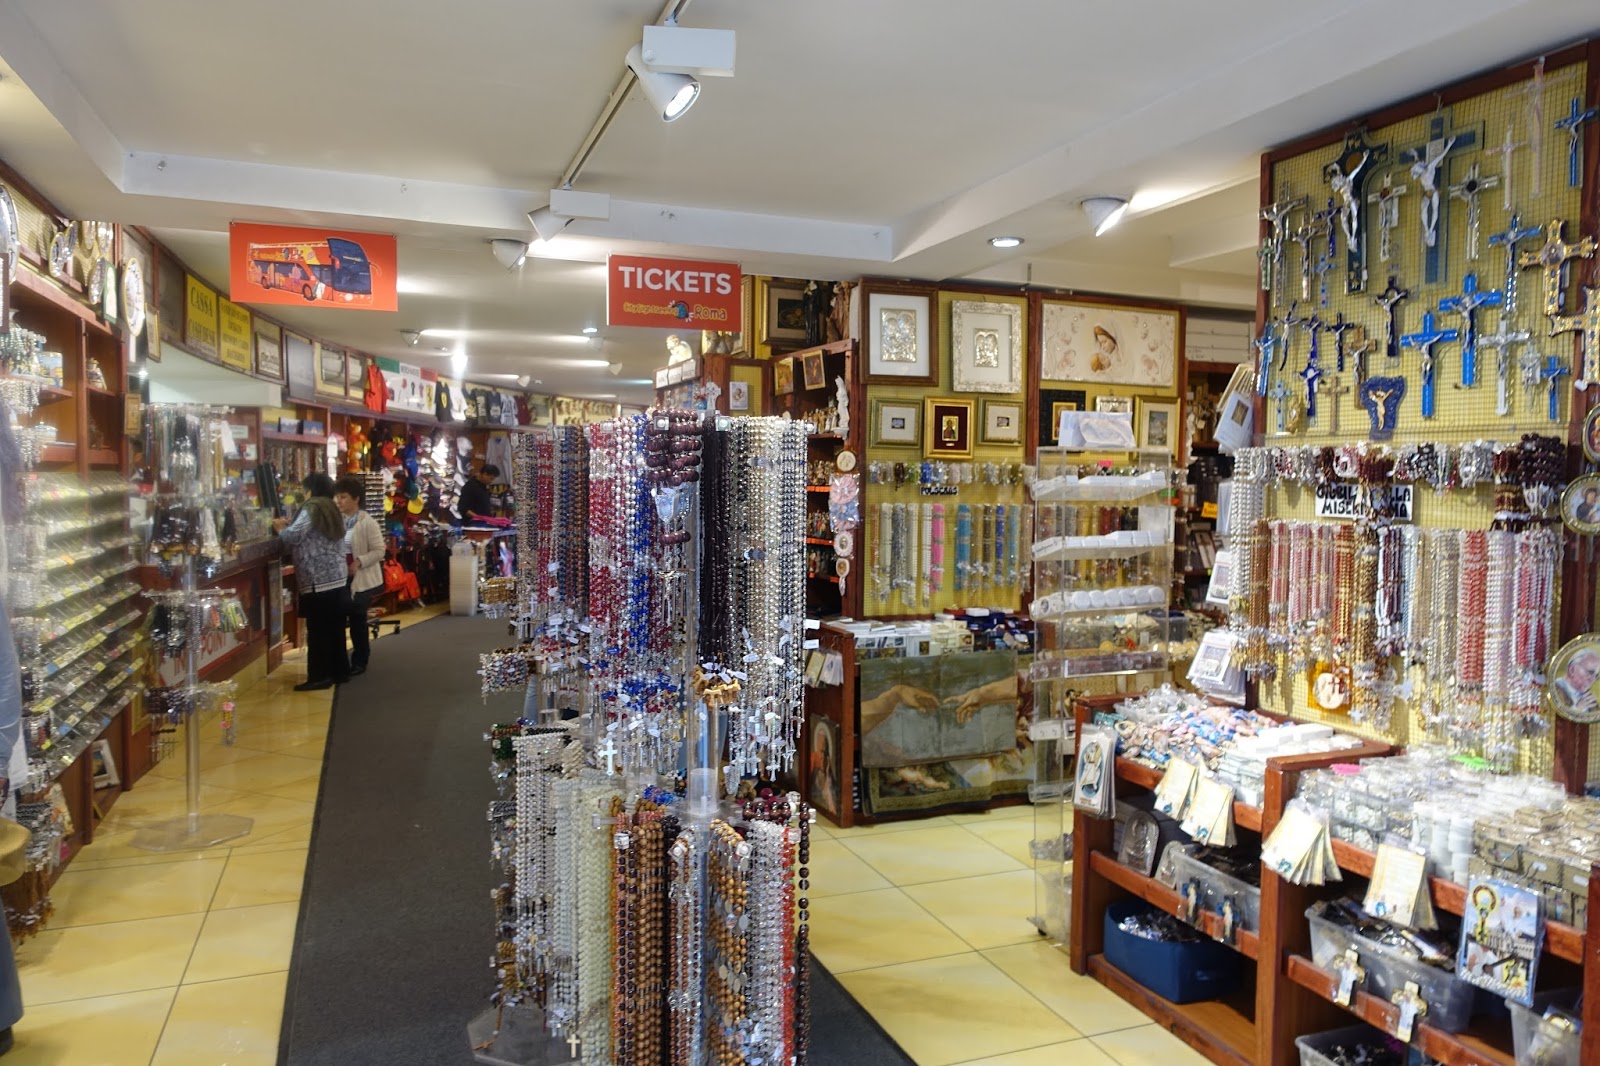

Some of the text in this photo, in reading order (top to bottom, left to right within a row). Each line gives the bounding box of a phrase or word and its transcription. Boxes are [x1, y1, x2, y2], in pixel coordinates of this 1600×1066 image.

[618, 265, 732, 295] TICKETS
[190, 286, 214, 318] CASSA
[693, 304, 728, 321] Roma
[1316, 482, 1366, 500] GIUBIL
